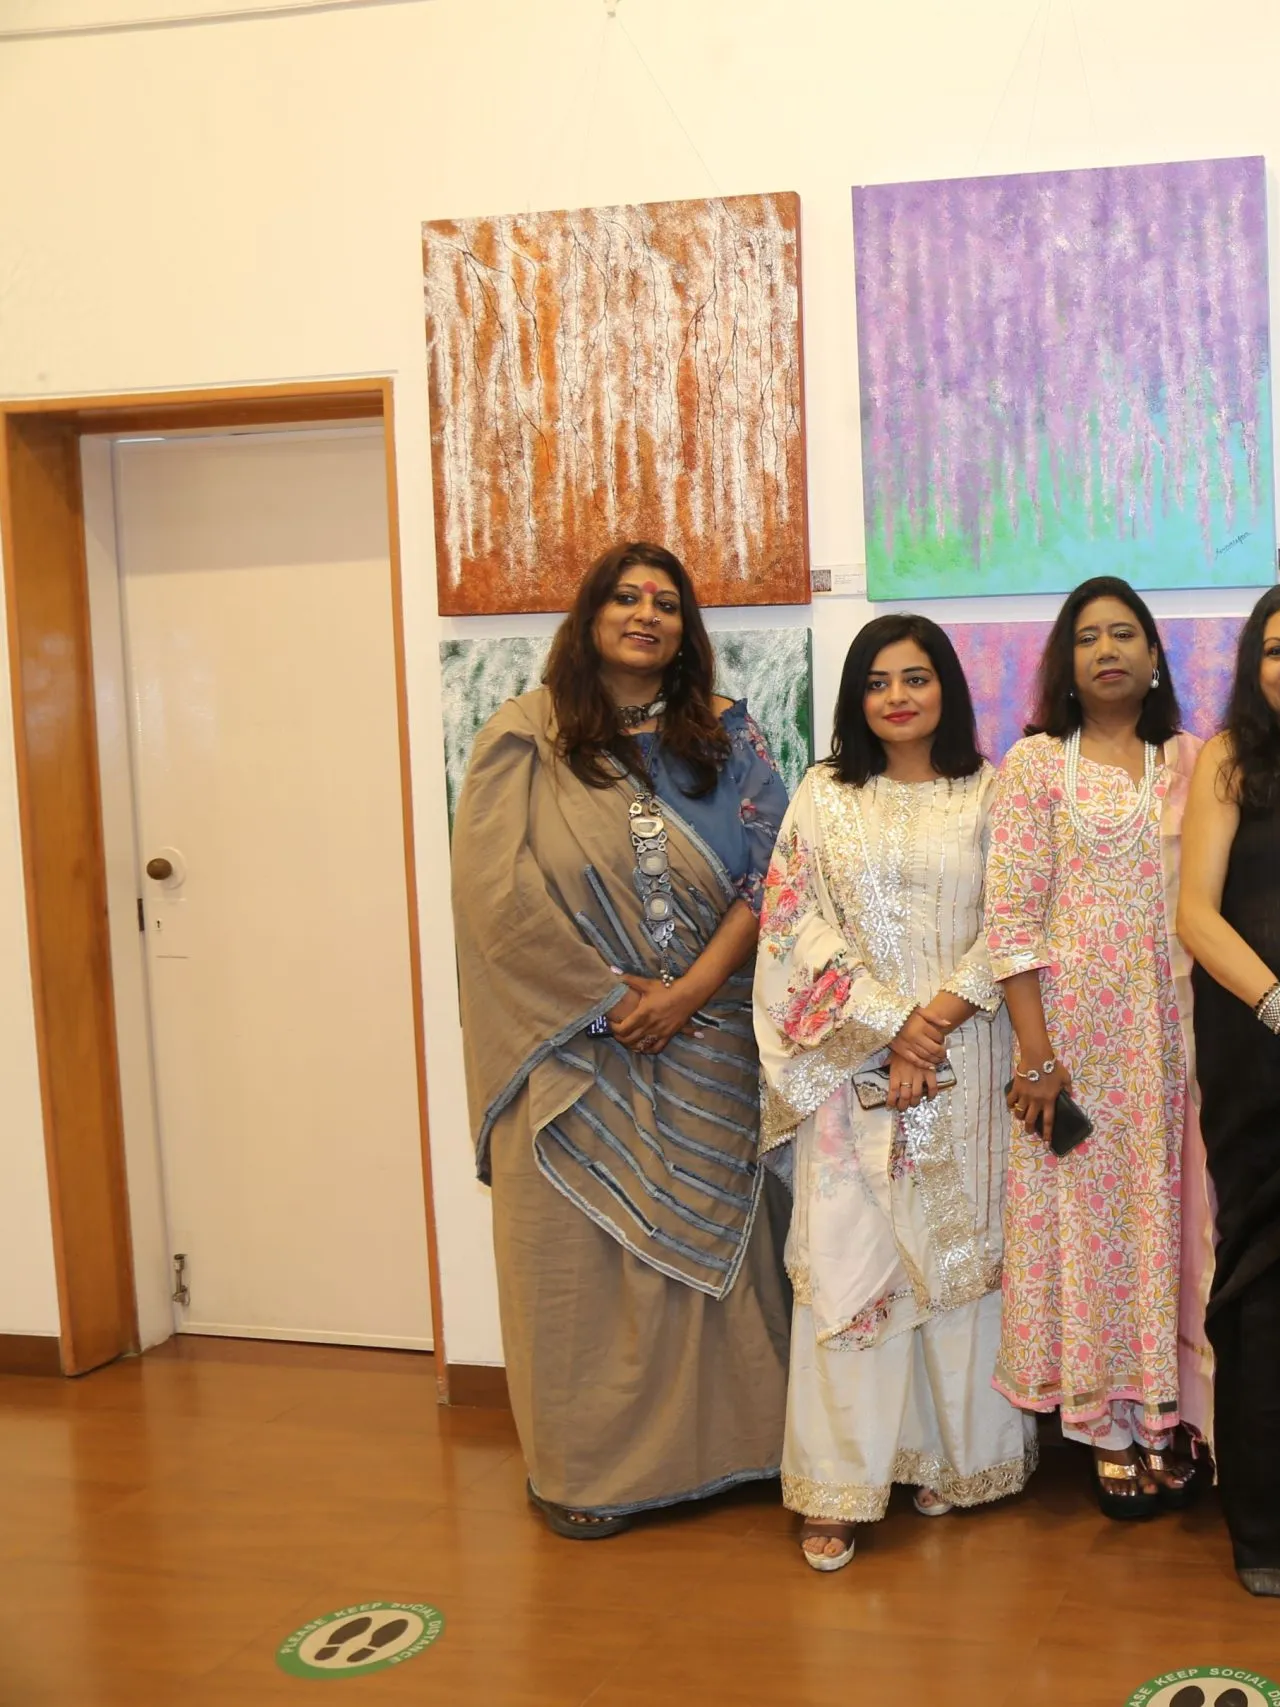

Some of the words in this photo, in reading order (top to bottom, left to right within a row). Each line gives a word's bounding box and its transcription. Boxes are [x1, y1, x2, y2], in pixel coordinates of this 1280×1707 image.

[334, 1602, 383, 1618] KEEP
[390, 1602, 437, 1619] SOCIAL
[280, 1618, 328, 1654] PLEASE
[389, 1620, 443, 1664] DISTANCE
[1128, 1687, 1153, 1707] ASE
[1154, 1669, 1199, 1687] KEEP
[1209, 1667, 1268, 1689] SOCIAL
